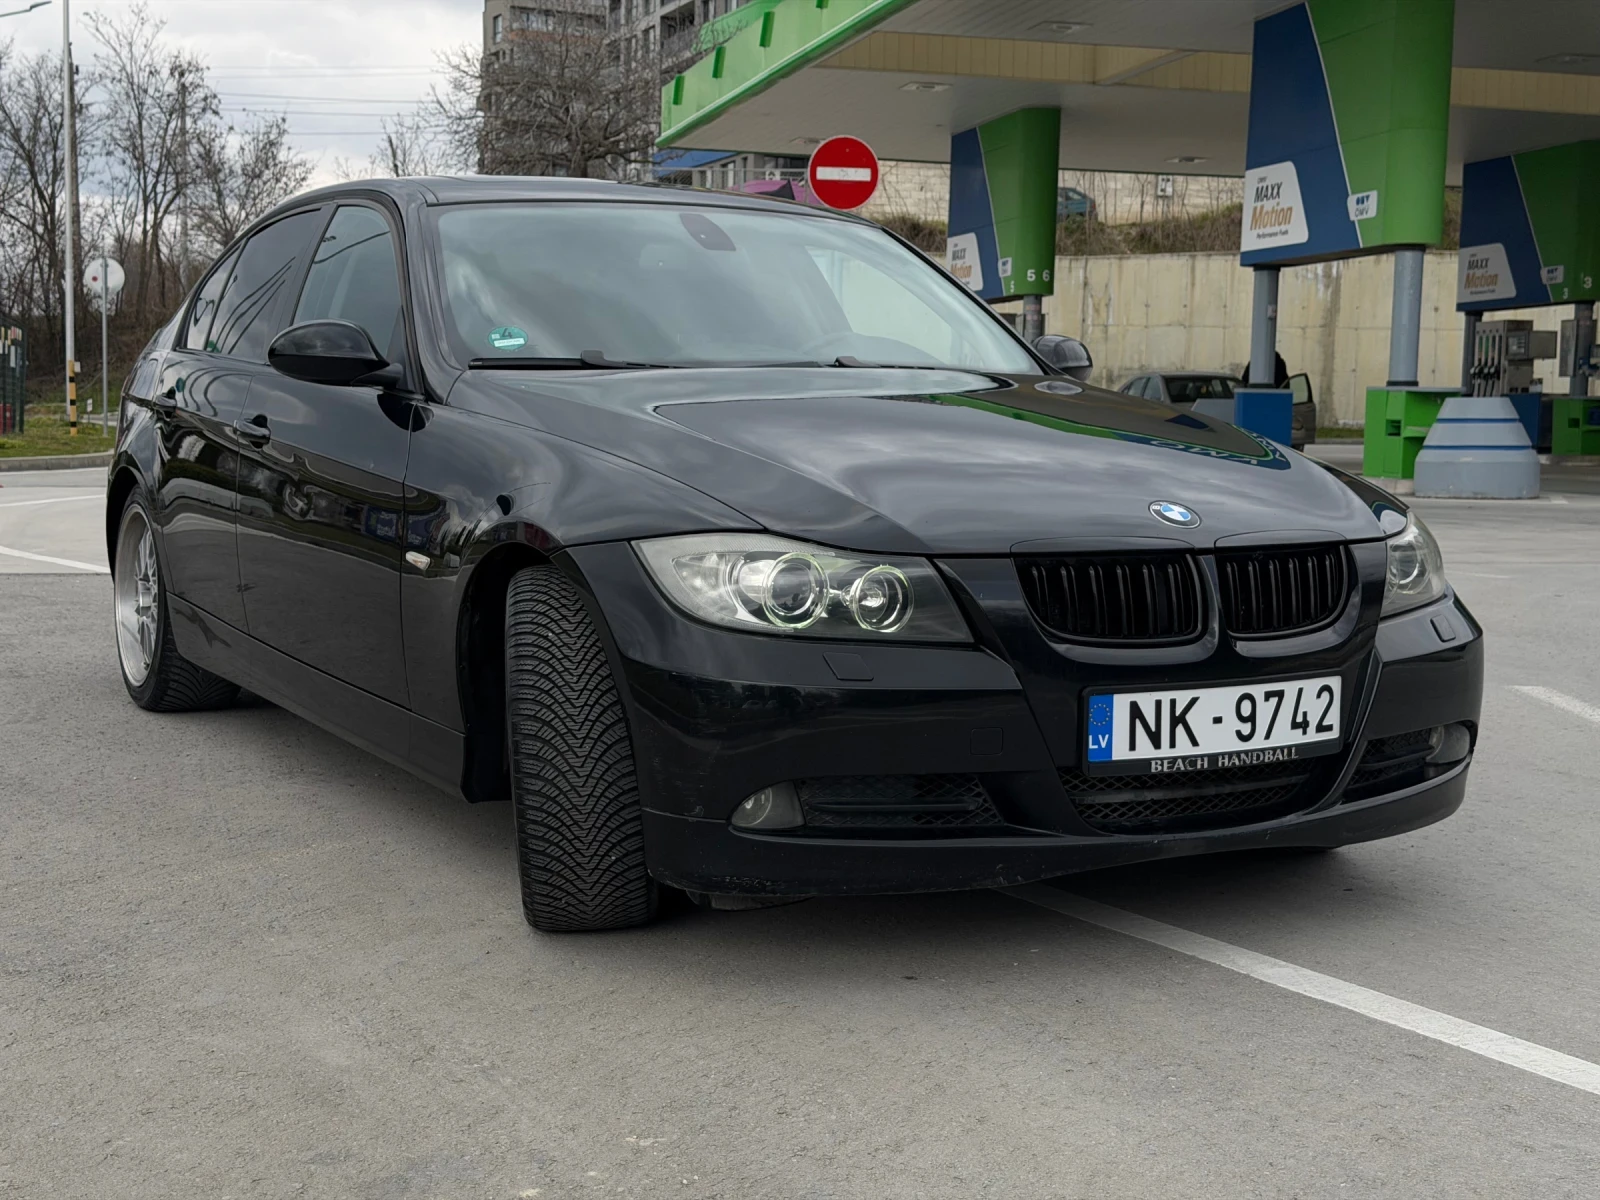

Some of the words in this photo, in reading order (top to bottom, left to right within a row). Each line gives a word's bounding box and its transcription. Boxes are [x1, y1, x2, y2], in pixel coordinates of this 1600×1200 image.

[1253, 181, 1283, 204] MAXX
[1250, 201, 1293, 231] Motion
[1467, 258, 1489, 270] MAXX
[1027, 269, 1036, 282] 5
[1042, 269, 1050, 282] 6
[1464, 271, 1498, 289] Motion
[1583, 276, 1592, 288] 3
[502, 328, 513, 338] 4
[1088, 734, 1109, 749] LV
[1149, 757, 1209, 773] BEACH
[1217, 746, 1300, 767] HANDBALL
